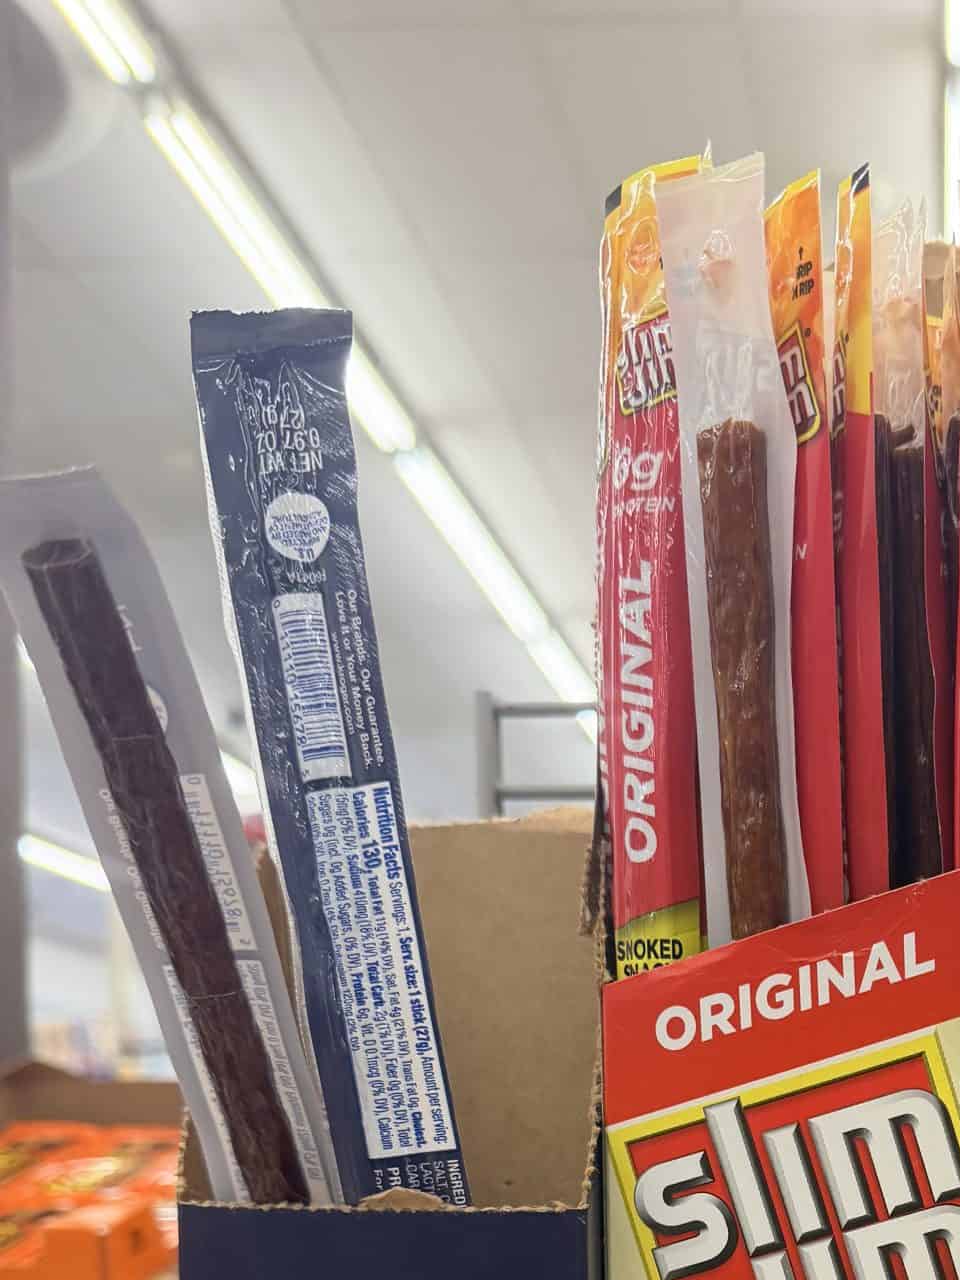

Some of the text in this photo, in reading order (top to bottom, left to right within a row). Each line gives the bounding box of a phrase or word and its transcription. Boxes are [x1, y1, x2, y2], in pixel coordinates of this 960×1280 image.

[346, 589, 360, 612] Our
[359, 668, 373, 691] Our
[344, 654, 359, 683] Your
[348, 685, 368, 731] Money
[617, 561, 656, 863] ORIGINAL
[350, 789, 374, 839] Calories
[371, 786, 397, 843] Nutrition
[381, 843, 403, 881] Facts
[409, 997, 427, 1025] stick
[655, 932, 936, 1051] ORIGINAL
[420, 1054, 439, 1092] Amount
[427, 1106, 450, 1145] serving:
